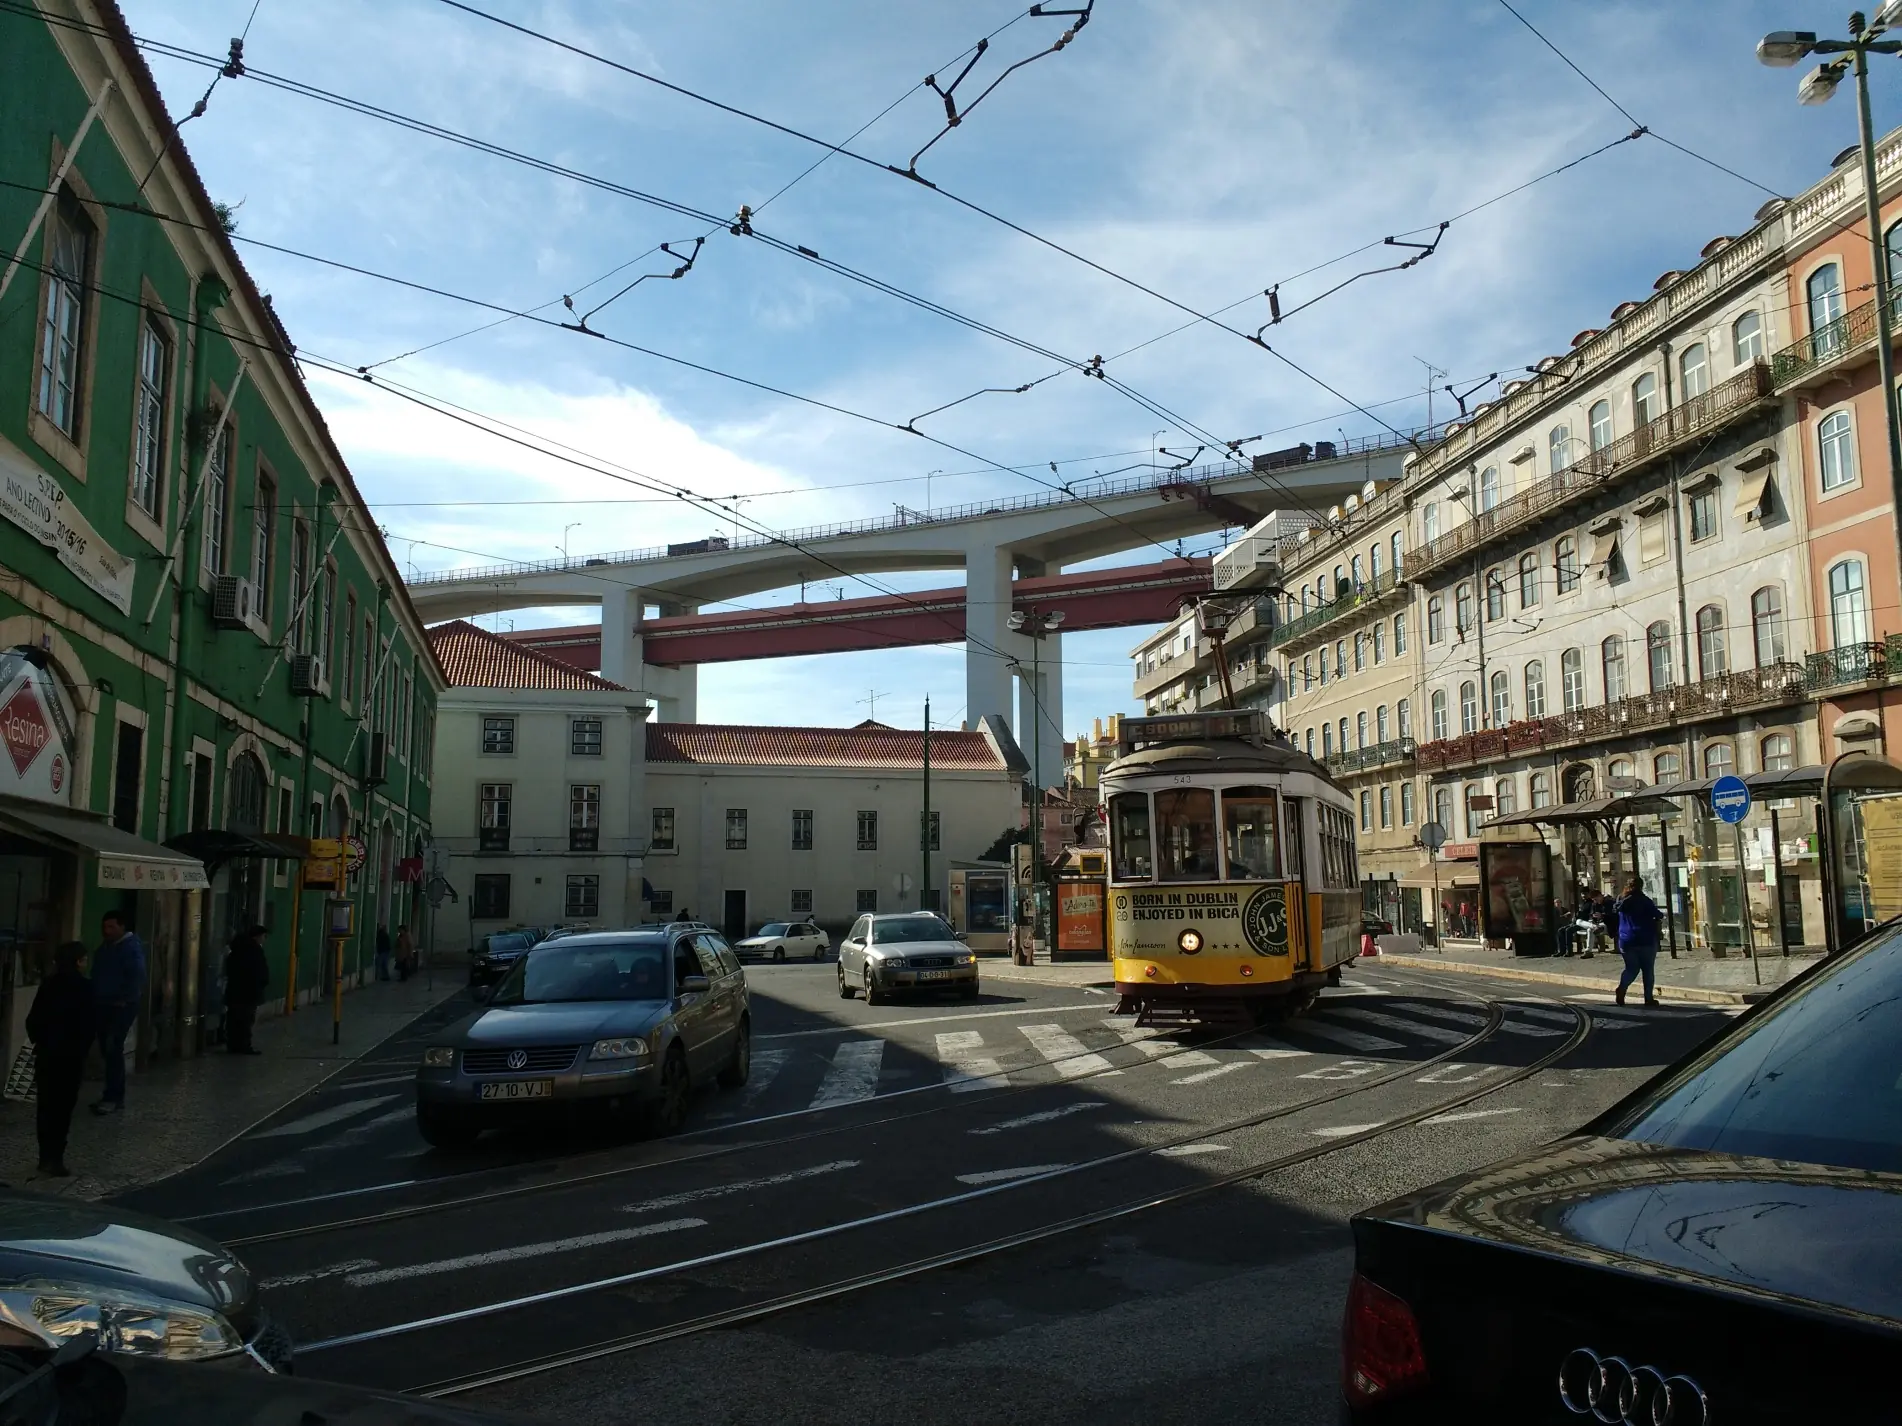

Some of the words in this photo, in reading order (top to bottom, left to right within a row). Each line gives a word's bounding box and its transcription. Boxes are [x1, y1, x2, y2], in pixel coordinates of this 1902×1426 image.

[6, 476, 23, 502] ANO
[56, 520, 87, 556] 2015/16
[1174, 775, 1192, 784] 543
[1132, 894, 1164, 905] BORN
[1168, 893, 1181, 905] IN
[1186, 892, 1238, 904] DUBLIN
[1133, 908, 1185, 920] ENJOYED
[1189, 908, 1203, 919] IN
[1207, 907, 1240, 919] BICA
[1249, 902, 1261, 929] JOHN
[1262, 942, 1279, 953] SON
